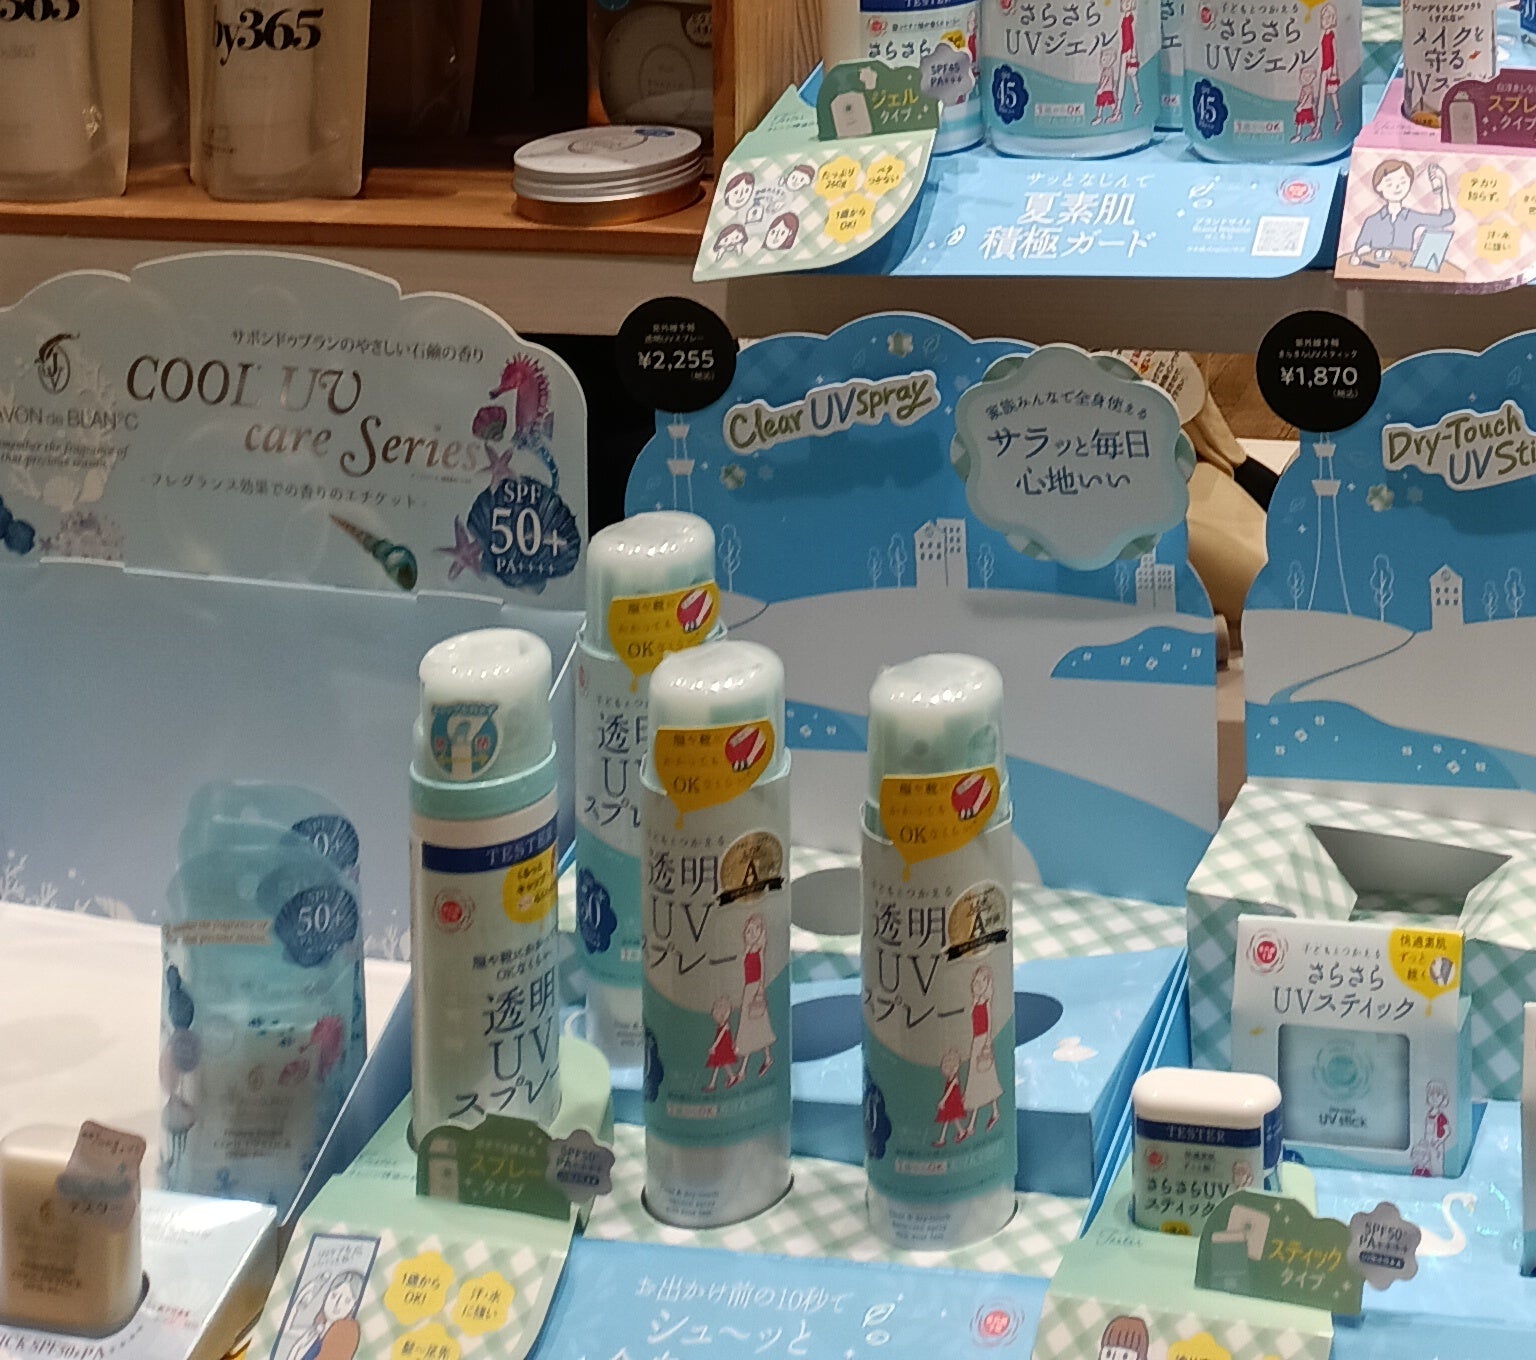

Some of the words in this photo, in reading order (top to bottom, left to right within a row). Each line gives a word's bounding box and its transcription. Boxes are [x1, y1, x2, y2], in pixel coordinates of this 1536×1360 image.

[1020, 2, 1102, 29] さらさら
[1220, 18, 1301, 44] さらさら
[868, 39, 931, 60] さらさら
[1005, 29, 1119, 57] UVジェル
[1205, 44, 1319, 73] UVジェル
[1425, 51, 1465, 73] 守る
[871, 88, 919, 109] ジェル
[880, 106, 912, 123] タイプ
[1500, 115, 1536, 131] タイプ
[1017, 191, 1136, 227] 夏素肌
[978, 226, 1157, 261] 積極ガード
[637, 351, 716, 372] ¥2,255
[126, 354, 259, 407] COOL
[279, 365, 363, 415] UV
[1280, 366, 1359, 389] ¥1,870
[729, 403, 804, 449] Clear
[809, 388, 858, 431] UV
[857, 379, 935, 422] spray
[244, 419, 332, 456] care
[339, 414, 480, 478] Series
[986, 427, 1151, 462] サラッと毎日
[1385, 404, 1522, 467] Dry-Touch
[1015, 465, 1131, 496] 心地いい
[1447, 452, 1489, 485] UV
[502, 484, 541, 504] SPF
[488, 507, 567, 556] 50+
[648, 848, 719, 896] 透明
[652, 897, 716, 942] UV
[872, 904, 947, 950] 透明
[1399, 932, 1448, 952] 快適素肌
[877, 949, 944, 995] UV
[1307, 961, 1386, 990] さらさら
[483, 967, 556, 1036] 透明
[1271, 986, 1416, 1021] UVスティック
[490, 1018, 553, 1081] UV
[1166, 1125, 1226, 1144] TESTER
[1318, 1113, 1338, 1126] UV
[1339, 1114, 1369, 1129] stick
[1268, 1236, 1344, 1271] スティック
[1280, 1268, 1325, 1291] タイプ
